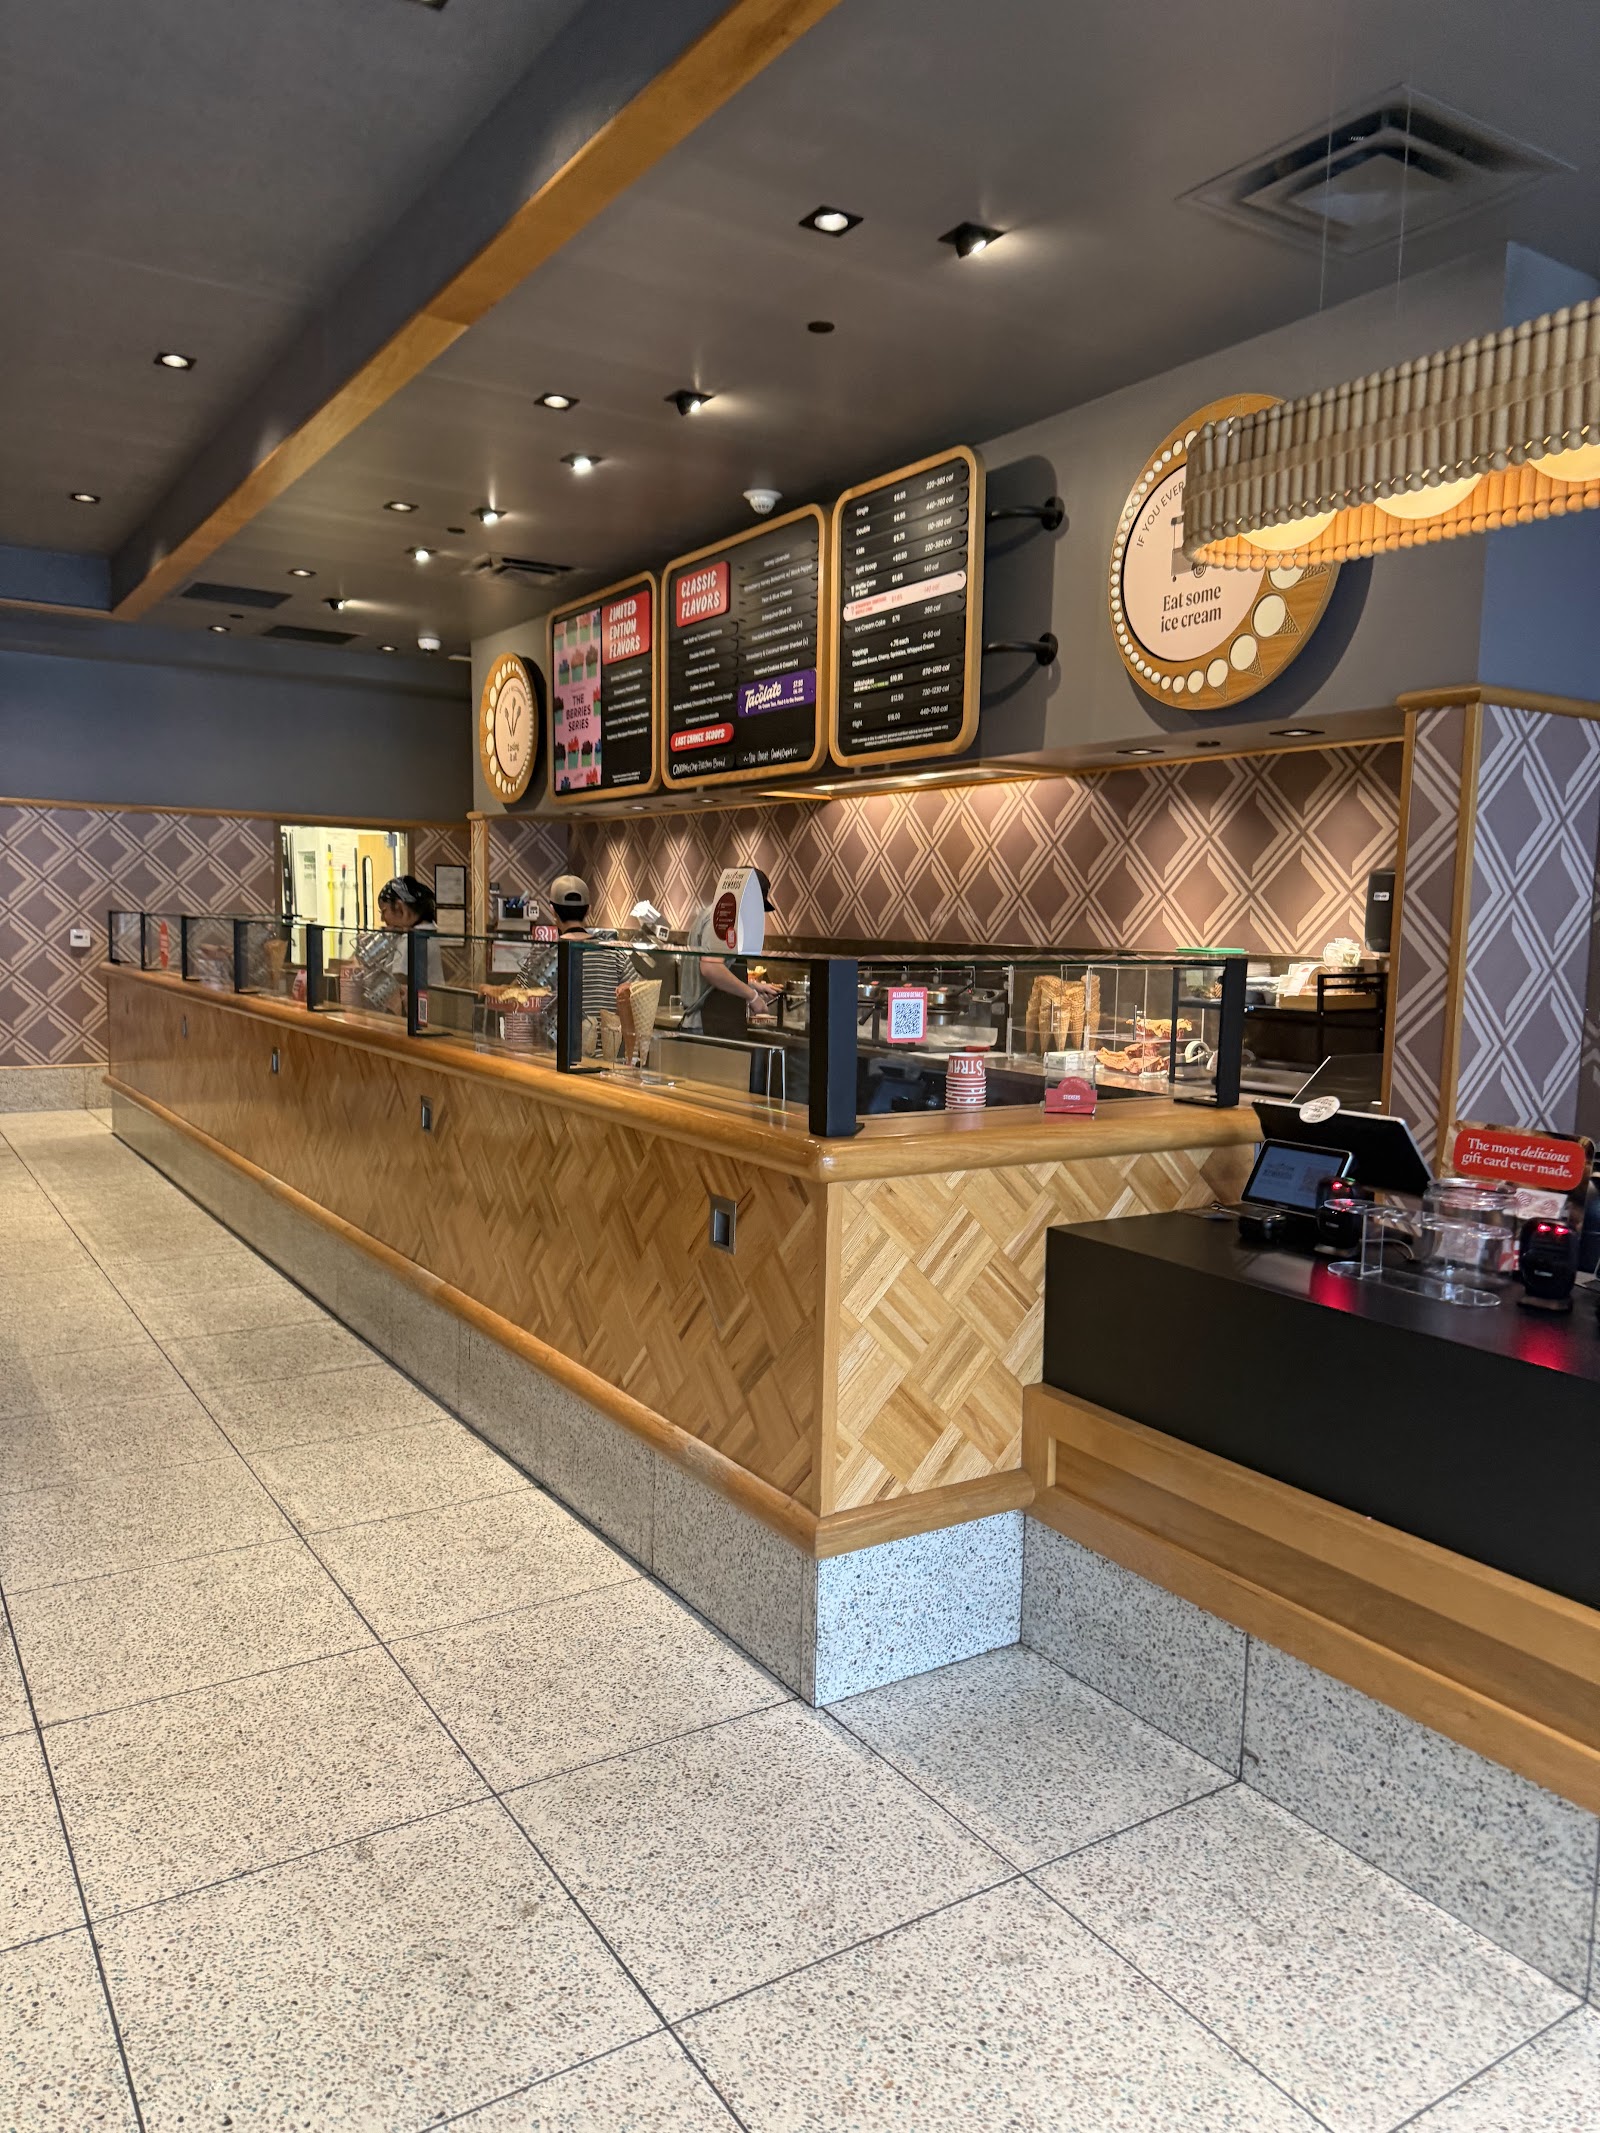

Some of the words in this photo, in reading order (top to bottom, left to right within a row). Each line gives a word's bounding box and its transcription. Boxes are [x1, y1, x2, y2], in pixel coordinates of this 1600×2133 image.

[1136, 535, 1144, 547] IF
[1142, 504, 1160, 532] YOU
[1160, 481, 1185, 508] EVER
[681, 570, 717, 599] CLASSIC
[609, 600, 636, 622] LIMITED
[682, 590, 720, 619] FLAVORS
[1163, 592, 1183, 612] Eat
[1186, 585, 1221, 605] some
[609, 618, 636, 640] EDITION
[1161, 615, 1178, 633] ice
[1181, 606, 1222, 628] cream
[609, 635, 640, 659] FLAVORS
[573, 694, 584, 706] THE
[745, 681, 781, 714] Tacolate
[566, 704, 591, 720] BERRIES
[568, 718, 589, 732] SERIES
[675, 735, 686, 747] LAST
[687, 732, 704, 745] CHANCE
[705, 728, 725, 741] SCOOPS
[1468, 1137, 1489, 1151] The
[1492, 1143, 1520, 1156] most
[1521, 1146, 1572, 1163] delicious
[1461, 1151, 1481, 1165] gift
[1483, 1156, 1509, 1168] card
[1510, 1162, 1535, 1172] ever
[1537, 1164, 1573, 1178] made.
